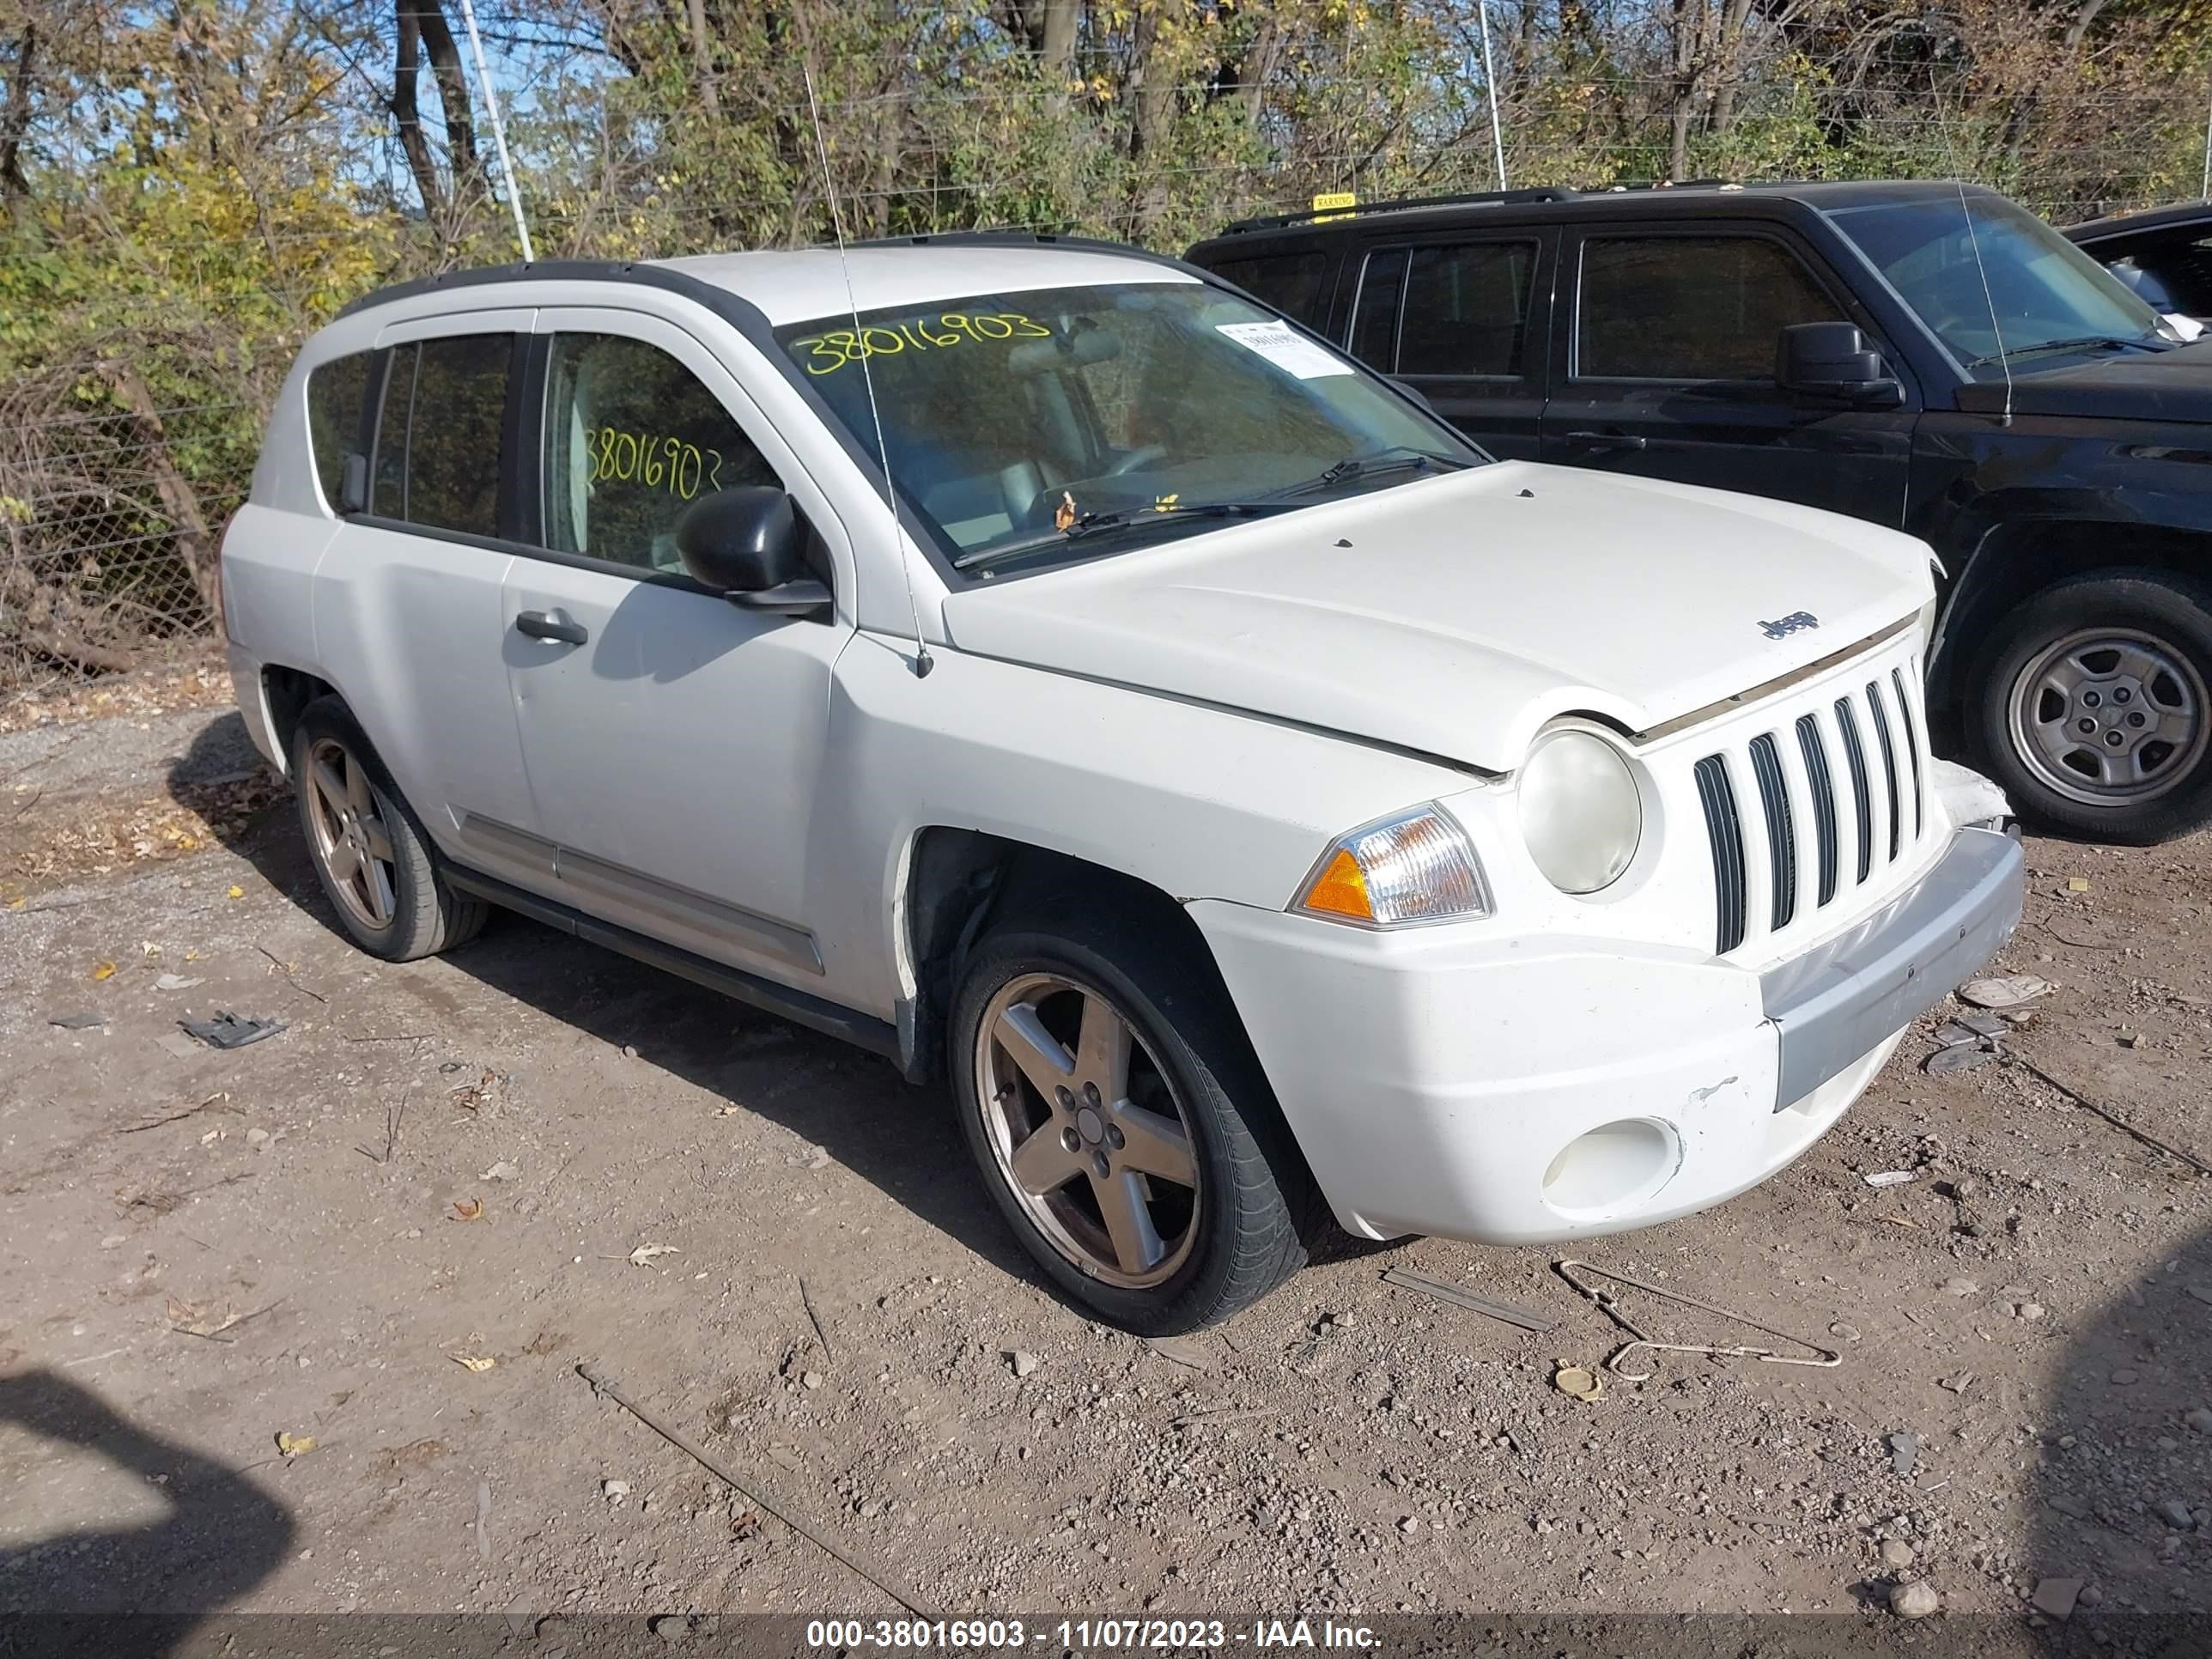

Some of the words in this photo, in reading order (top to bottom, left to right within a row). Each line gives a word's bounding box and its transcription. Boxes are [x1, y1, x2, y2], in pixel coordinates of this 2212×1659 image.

[1317, 197, 1352, 207] WARNING
[795, 313, 1051, 375] 38016903
[1756, 611, 1820, 641] Jeep
